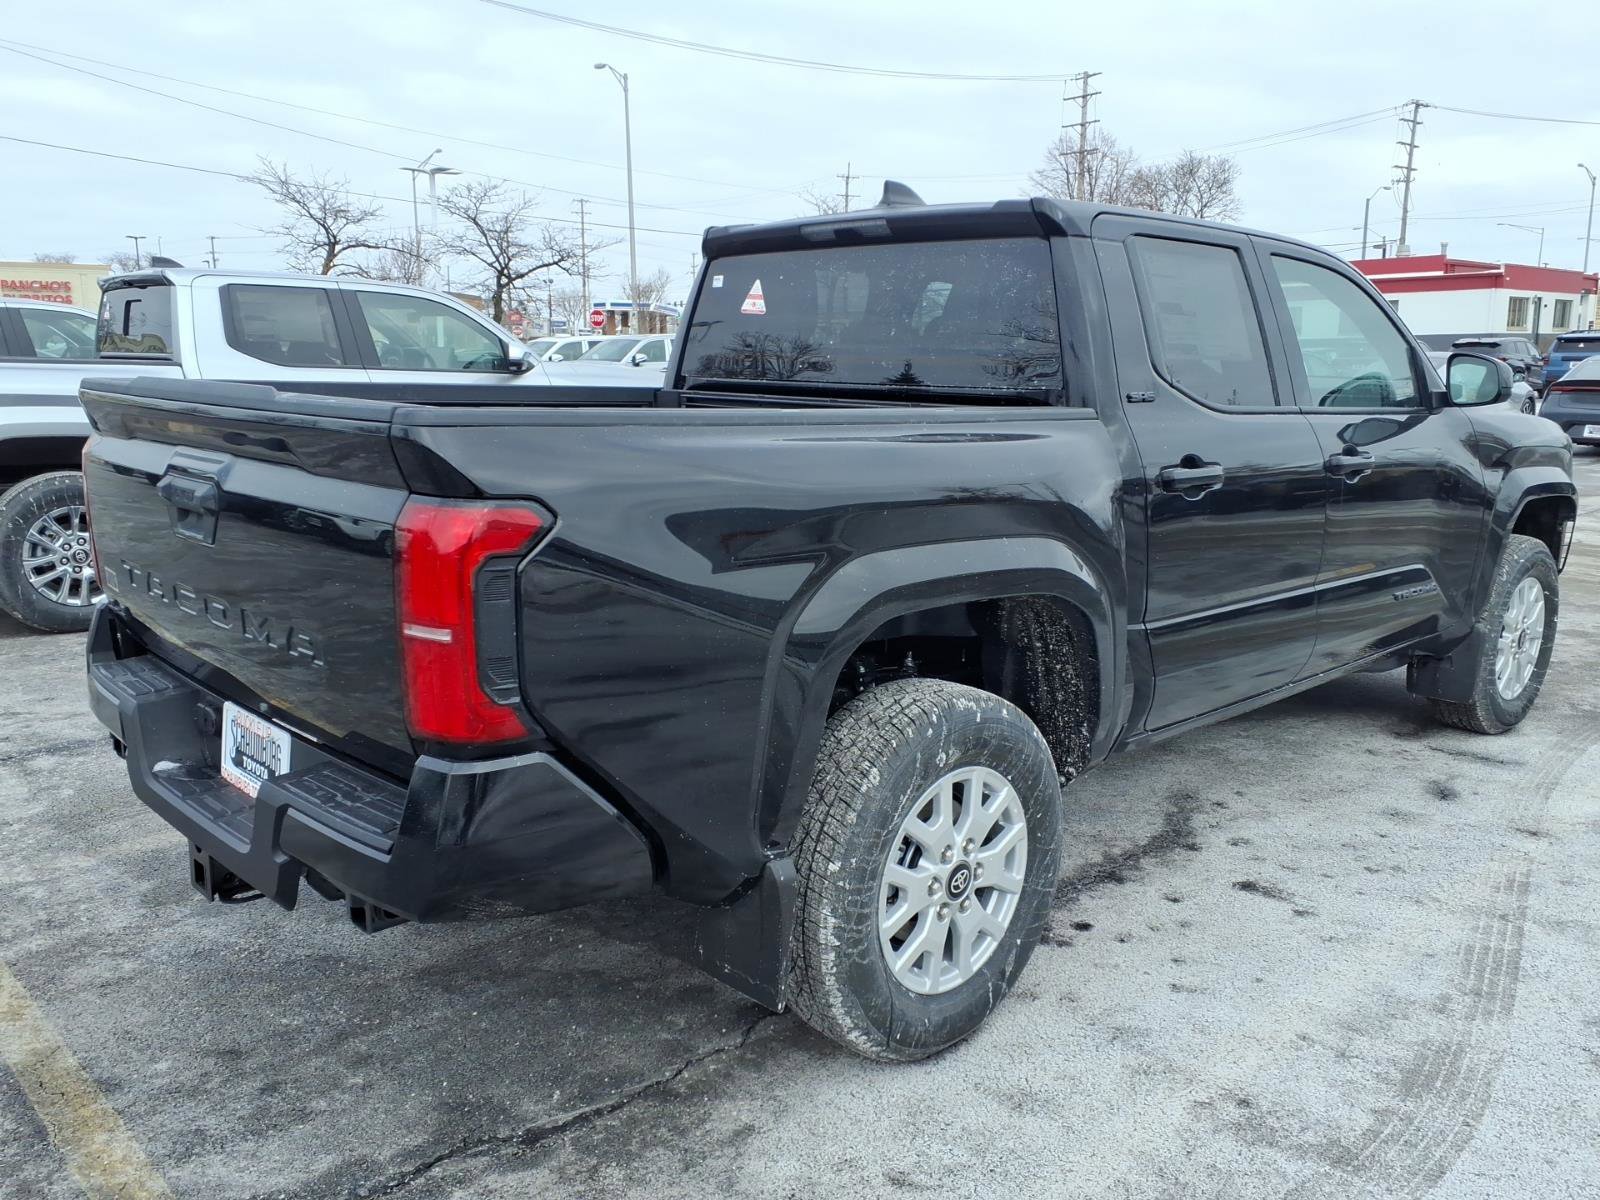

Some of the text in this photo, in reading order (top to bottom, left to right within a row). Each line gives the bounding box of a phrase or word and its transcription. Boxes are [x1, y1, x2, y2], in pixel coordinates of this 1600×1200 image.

[0, 280, 72, 292] RANCHO'S
[590, 314, 604, 322] STOP
[119, 558, 328, 667] TACOMA
[242, 756, 269, 780] TOYOTA
